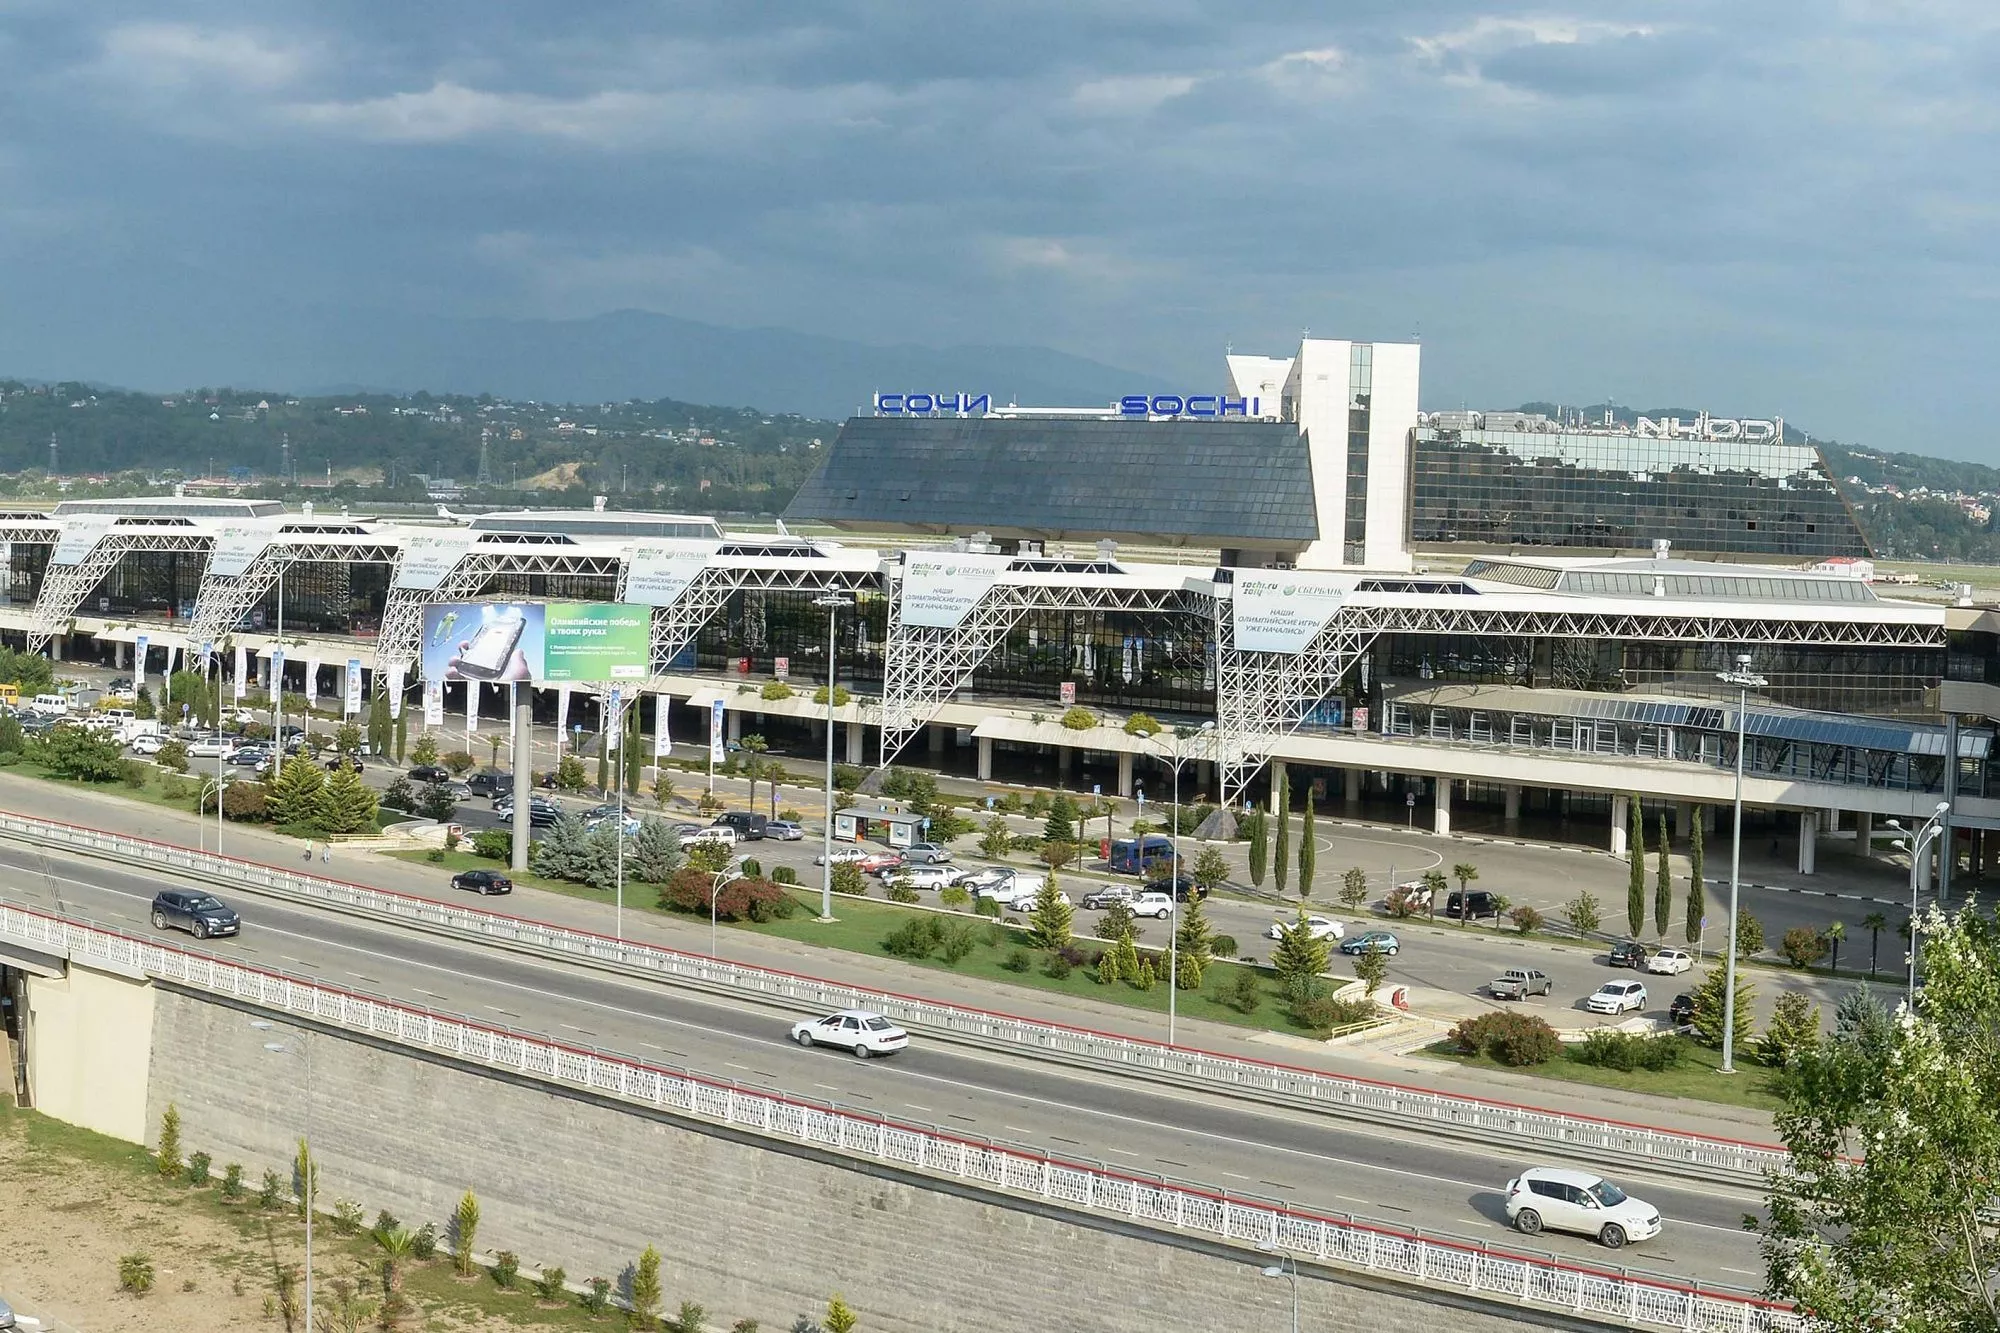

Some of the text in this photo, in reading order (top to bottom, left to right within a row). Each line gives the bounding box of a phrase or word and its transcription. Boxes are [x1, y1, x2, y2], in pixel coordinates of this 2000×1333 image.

[878, 394, 989, 413] СОЧИ
[1121, 395, 1260, 416] SOCHI
[1241, 581, 1278, 590] sochi.ru
[1297, 586, 1343, 596] СБЕРБАНК
[551, 617, 641, 627] Олимпийские победы
[1238, 615, 1321, 628] ОЛИМПИЙСКИЕ ИГРЫ
[582, 629, 607, 637] руках
[1262, 626, 1306, 636] НАЧАЛИСЬ!
